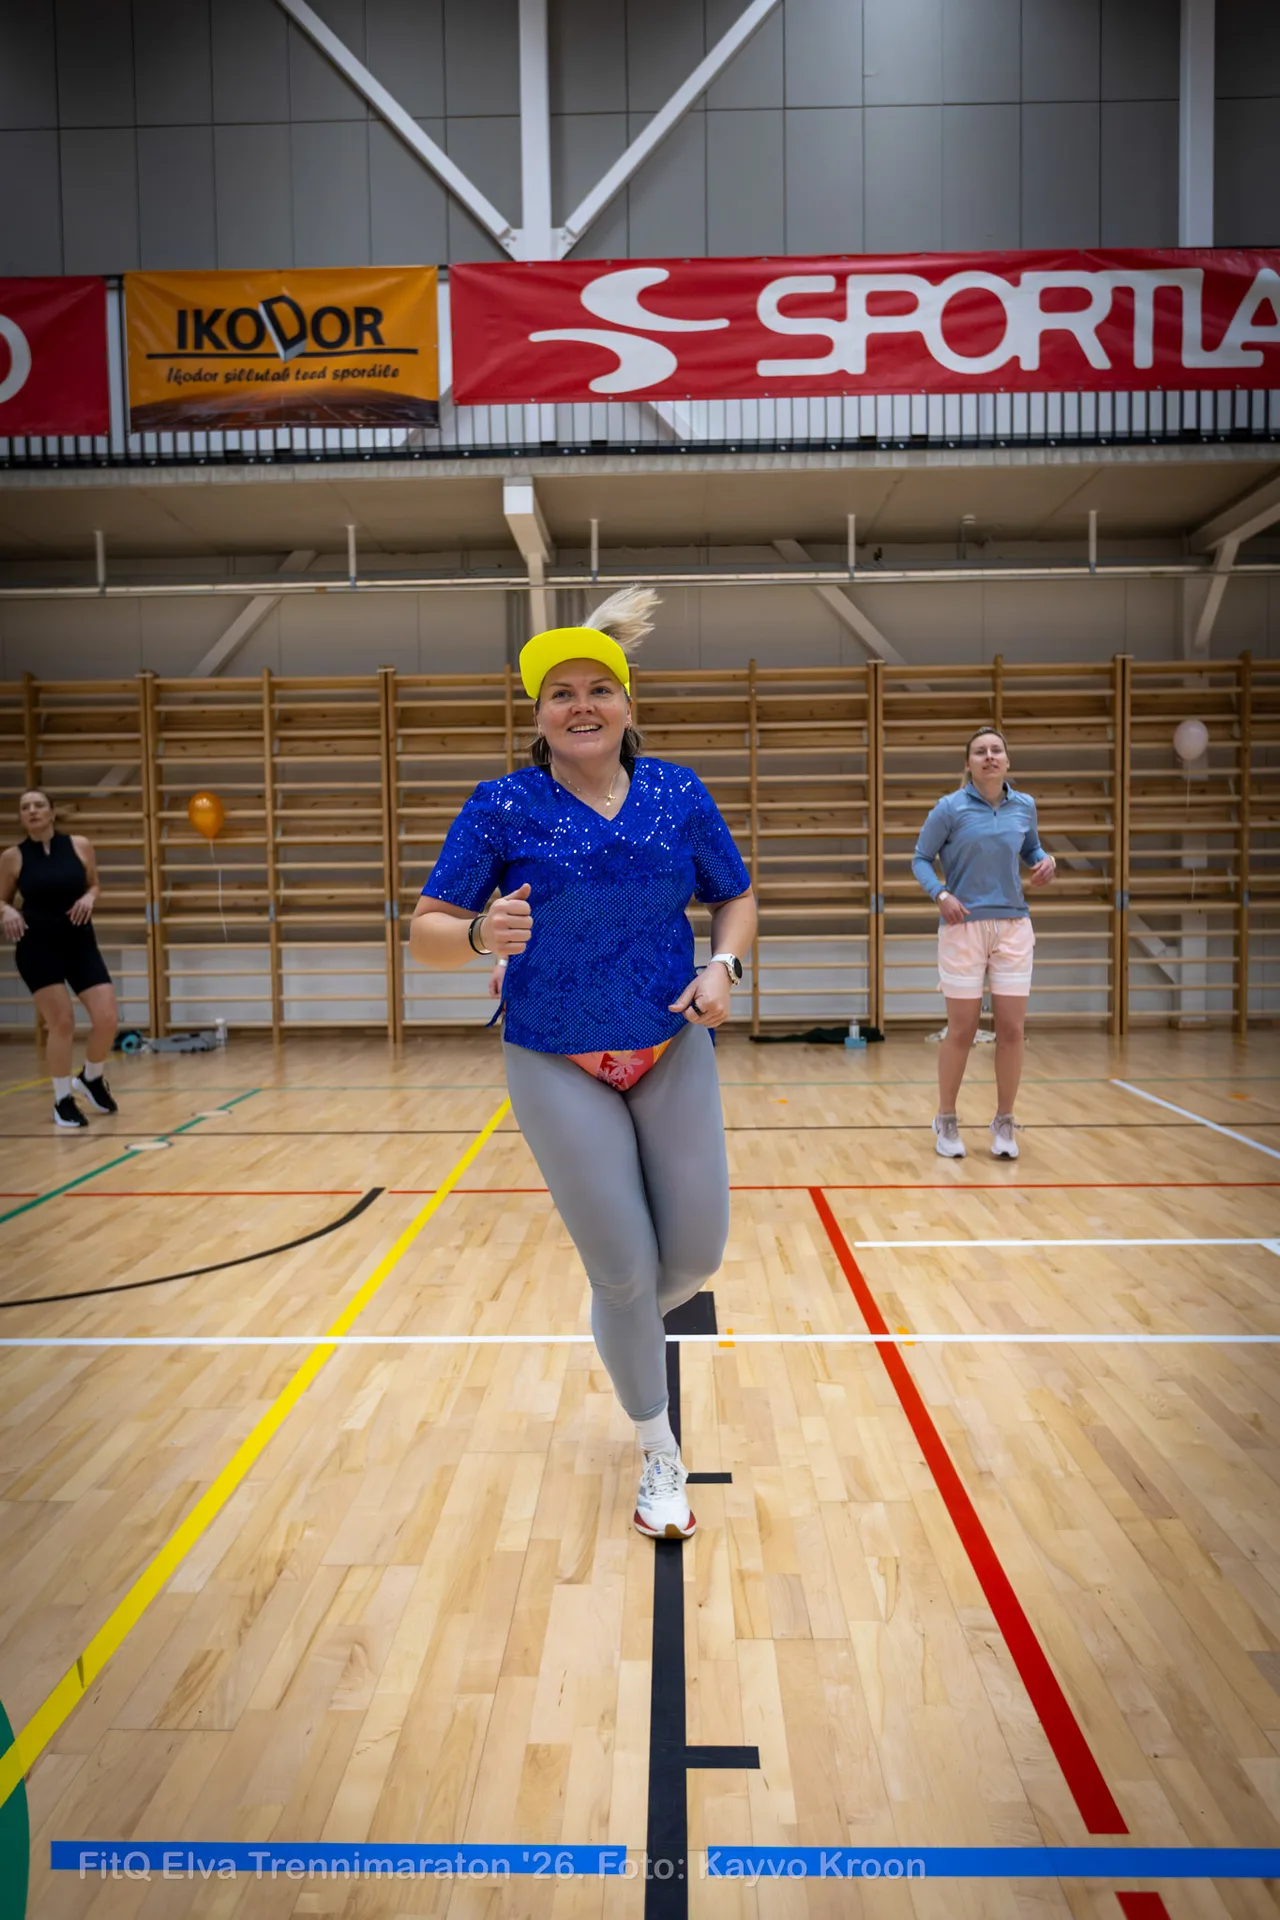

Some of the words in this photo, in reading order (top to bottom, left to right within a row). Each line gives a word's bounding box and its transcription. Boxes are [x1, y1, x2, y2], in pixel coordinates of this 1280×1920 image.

[177, 295, 385, 362] IKODOR
[756, 268, 1280, 376] SPORTLA
[166, 367, 219, 386] Ikodor
[332, 364, 400, 382] spordile
